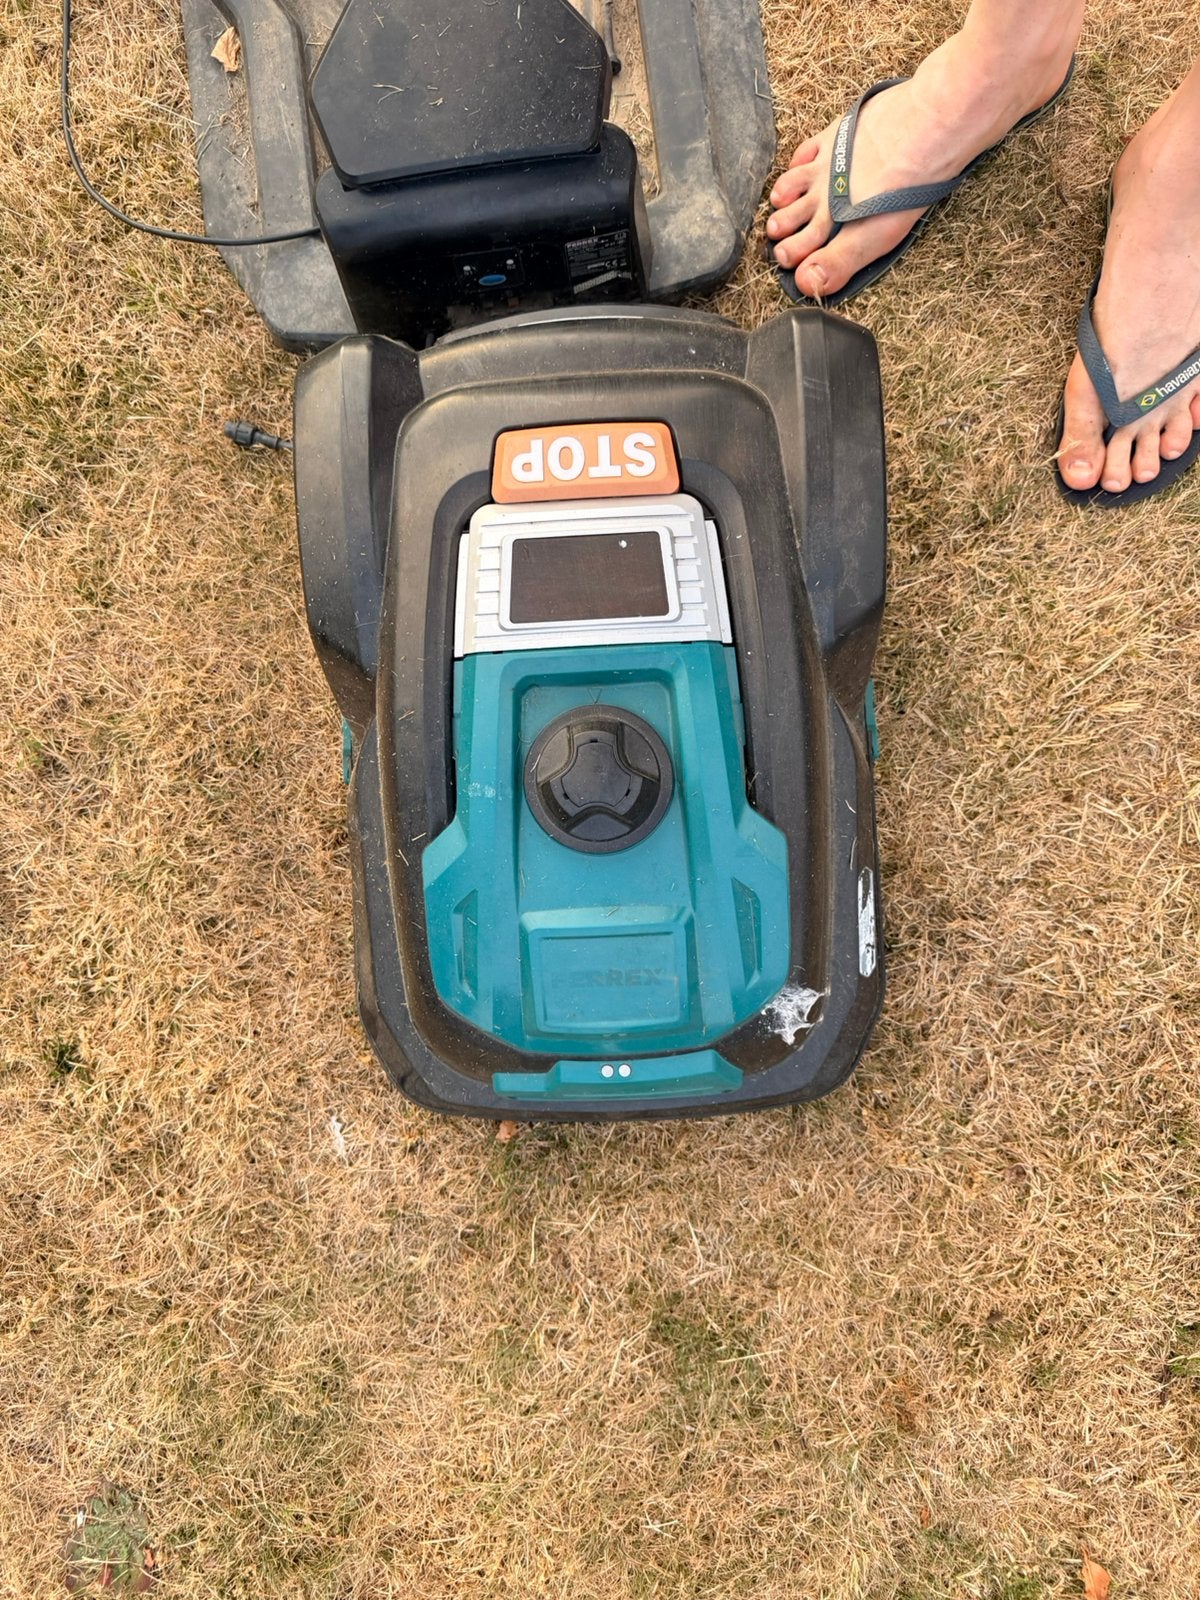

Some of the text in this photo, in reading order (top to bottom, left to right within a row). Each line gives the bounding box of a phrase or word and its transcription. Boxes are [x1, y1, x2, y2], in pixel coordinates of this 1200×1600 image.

[835, 114, 853, 173] havaianas
[1155, 358, 1200, 397] havaian
[511, 432, 656, 483] STOP
